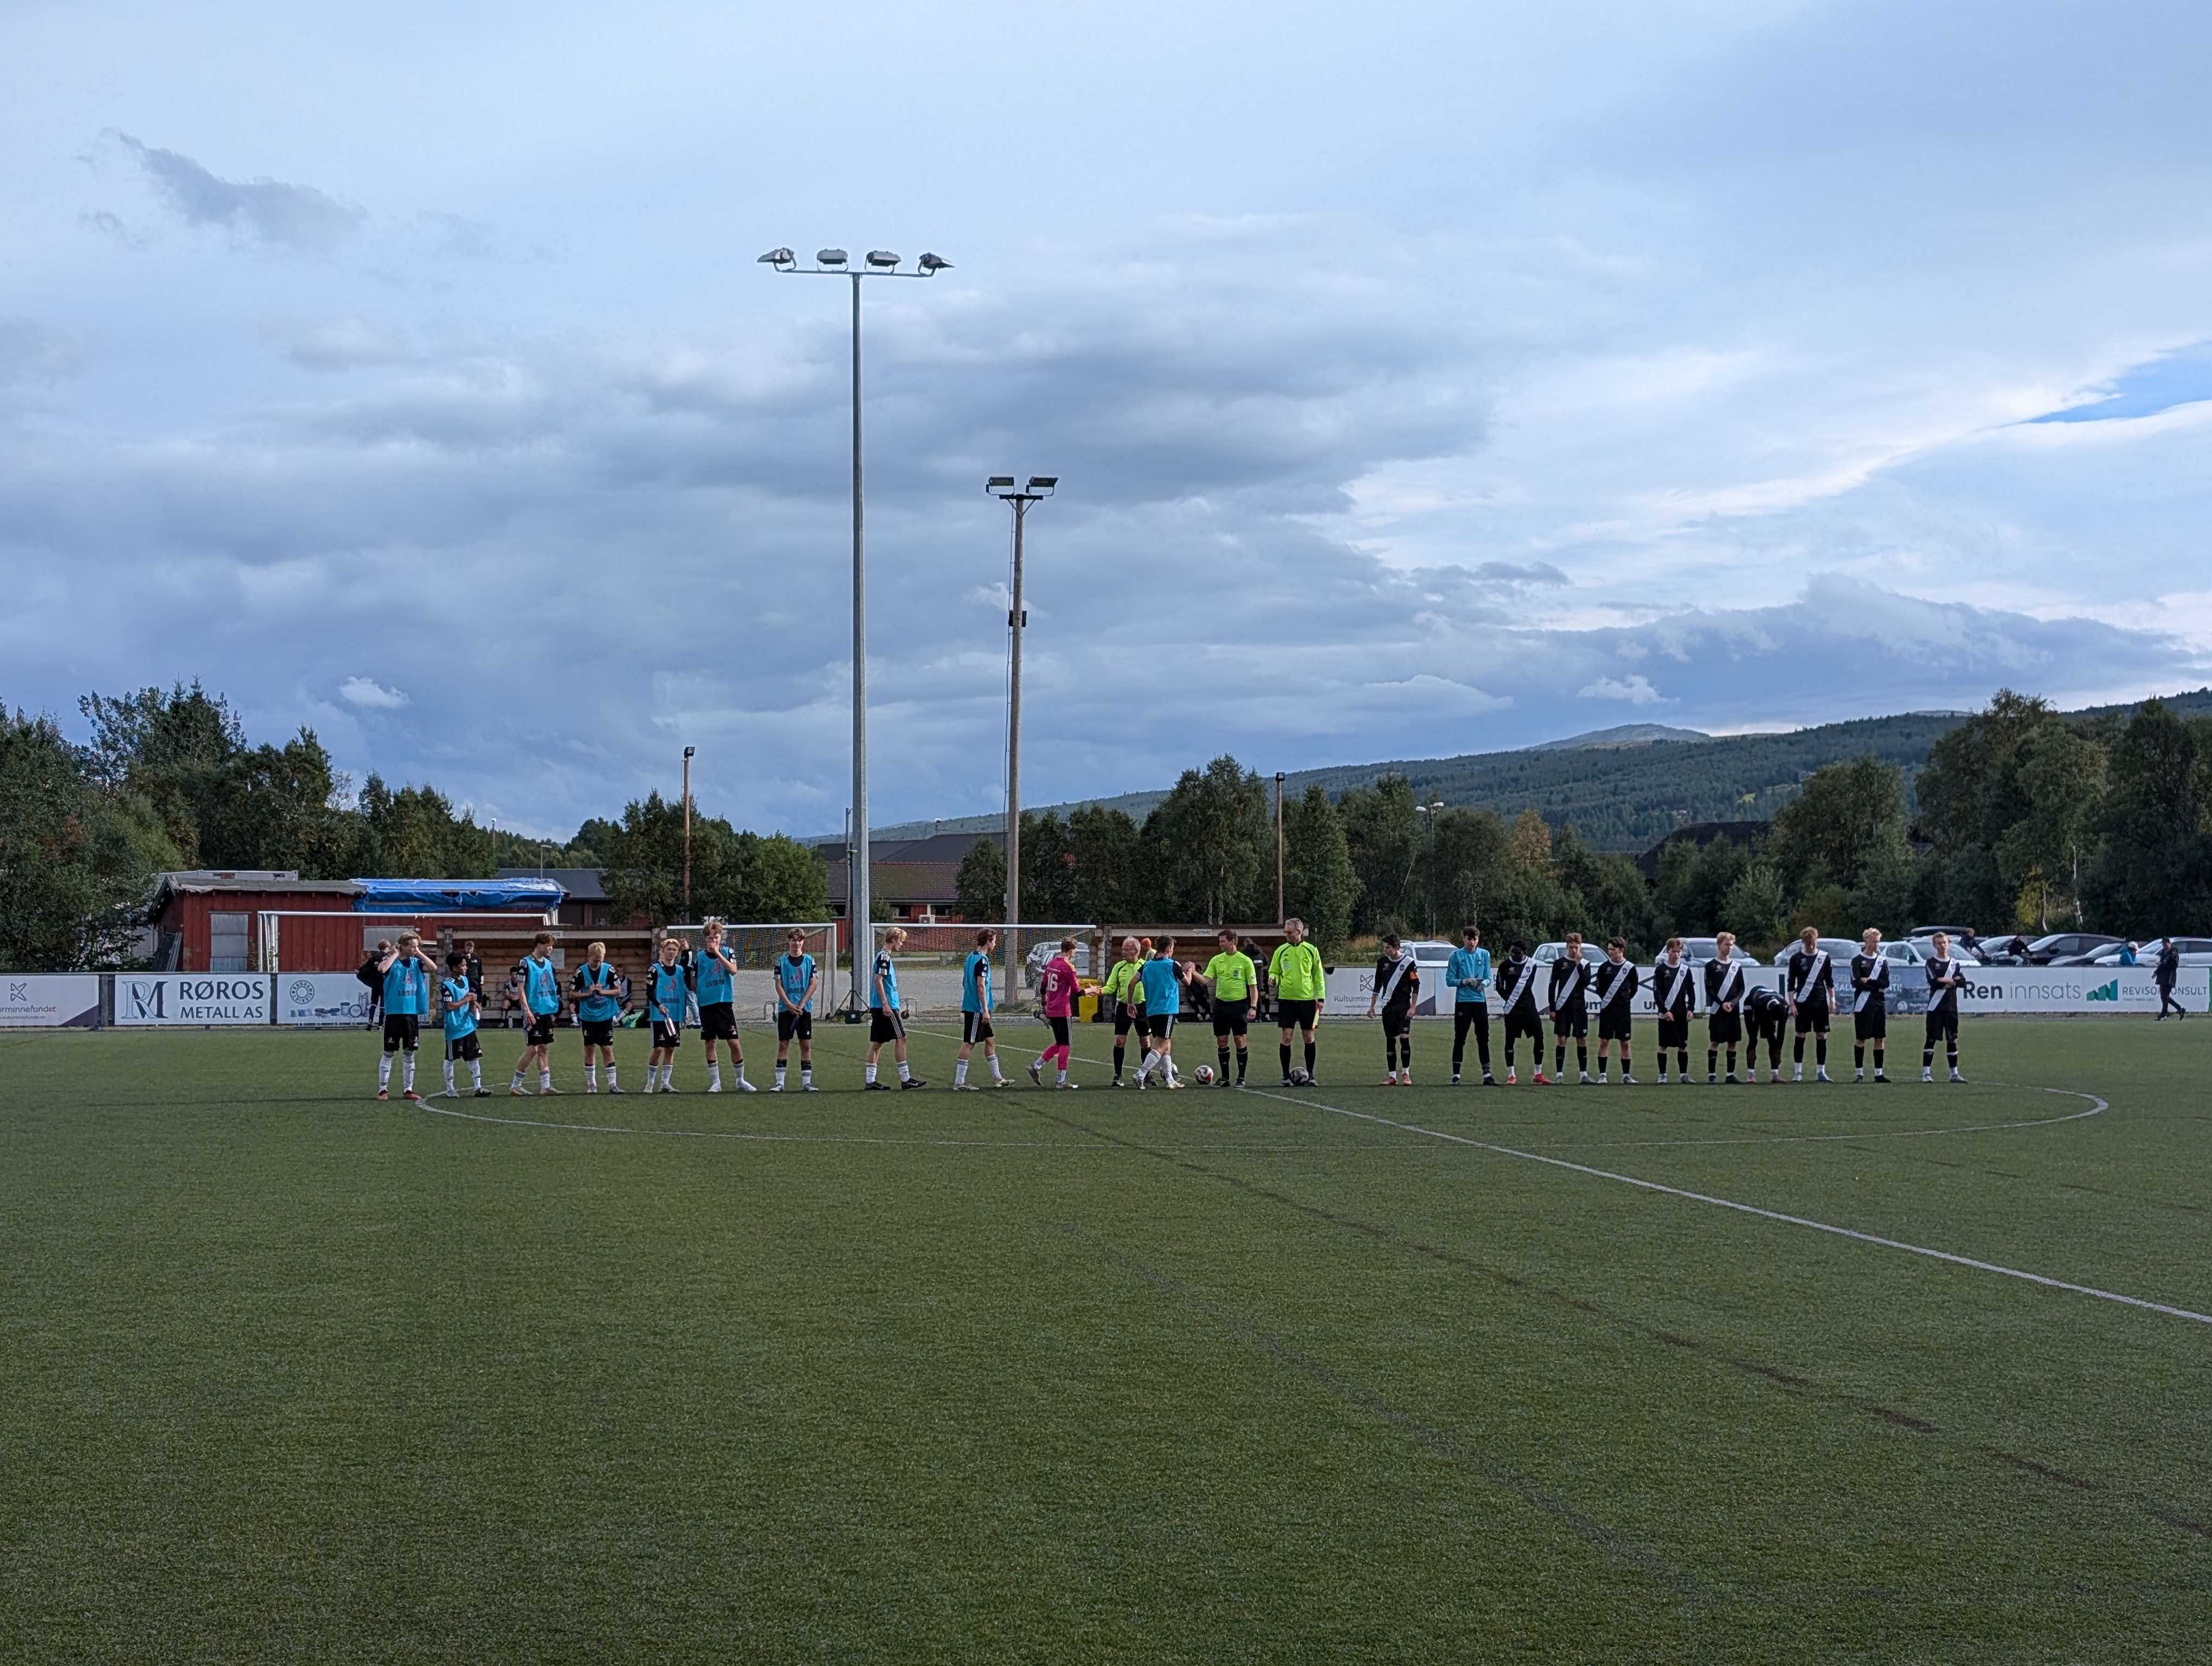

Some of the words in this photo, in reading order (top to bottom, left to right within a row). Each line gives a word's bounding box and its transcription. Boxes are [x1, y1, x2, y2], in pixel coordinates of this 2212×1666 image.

[179, 981, 263, 1001] RØROS
[1047, 972, 1058, 992] 16
[1963, 981, 2003, 999] Ren
[2010, 981, 2081, 999] innsats
[180, 1006, 240, 1018] METALL
[243, 1006, 263, 1018] AS
